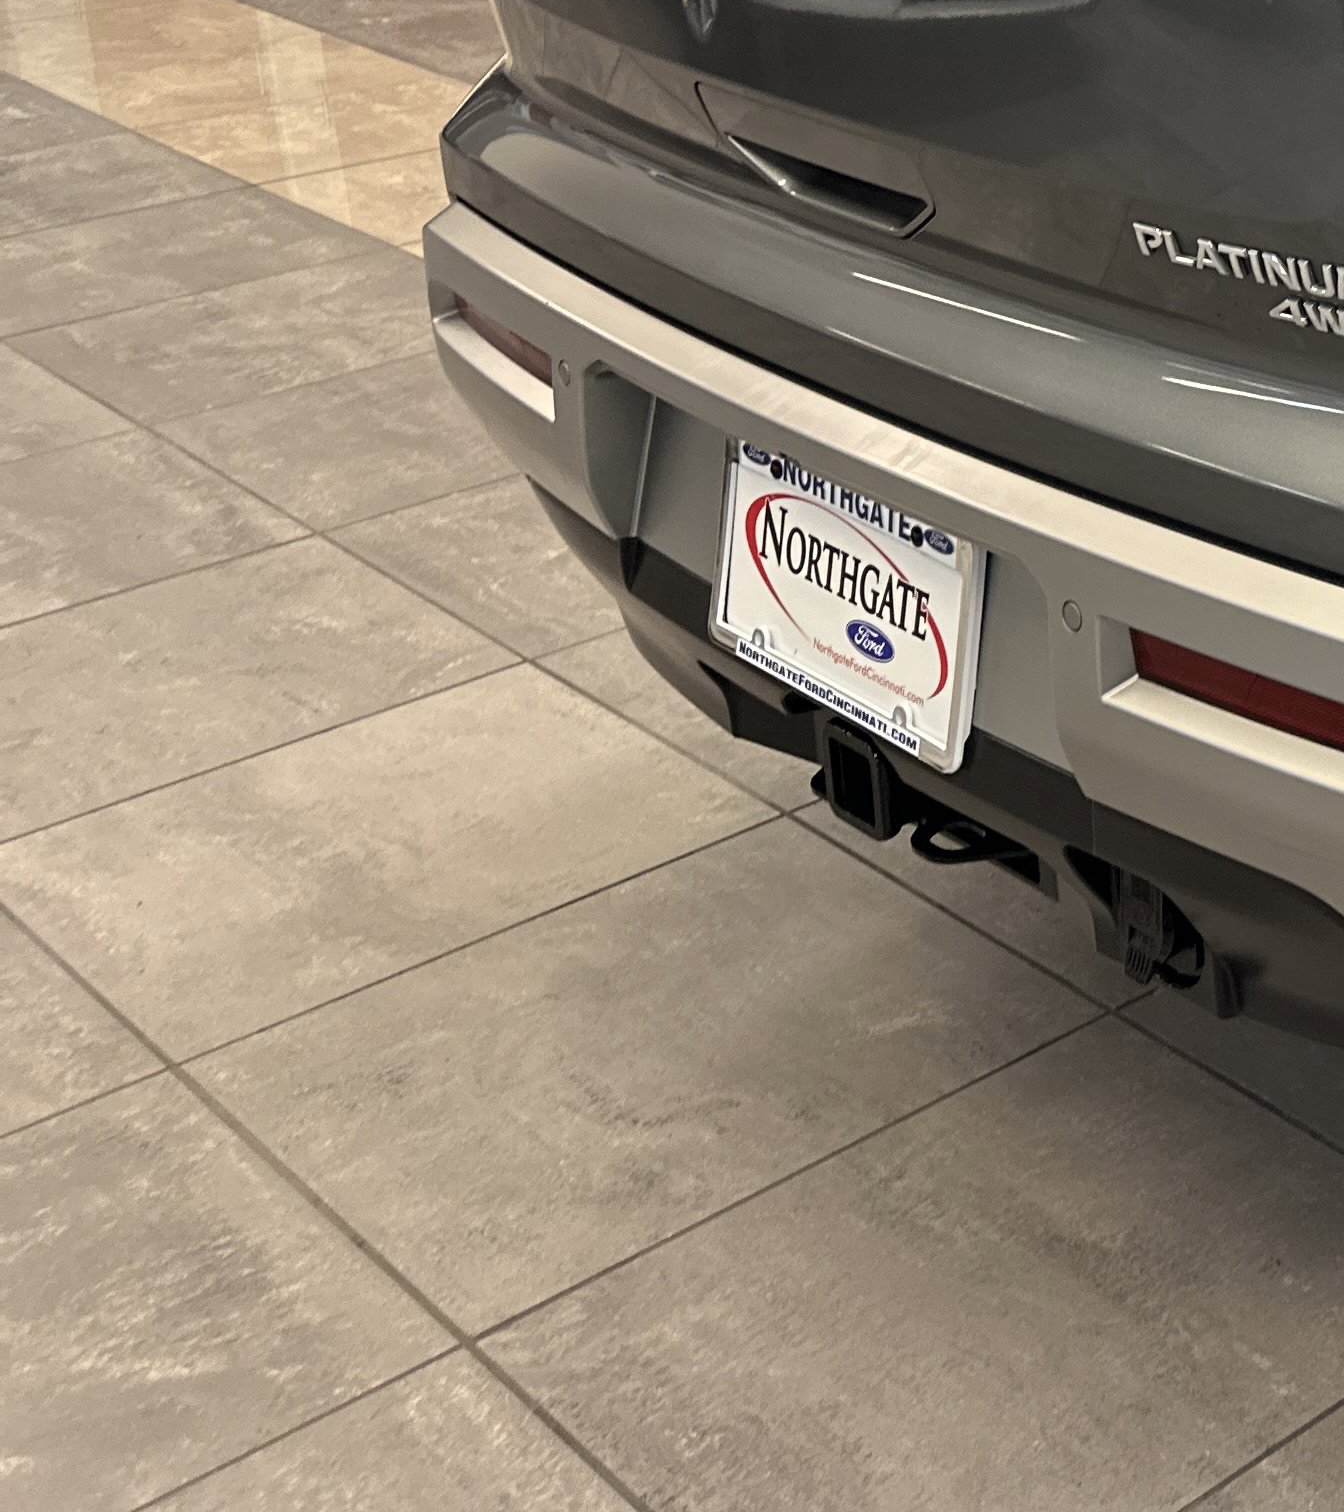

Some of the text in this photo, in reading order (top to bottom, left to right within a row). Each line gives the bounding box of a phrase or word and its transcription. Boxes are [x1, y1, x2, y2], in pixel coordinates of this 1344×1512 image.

[783, 459, 911, 542] NORTHGATE
[759, 498, 930, 640] NORTHGATE
[813, 637, 924, 707] NorthgateFordCincinnati.com
[853, 624, 887, 658] Ford
